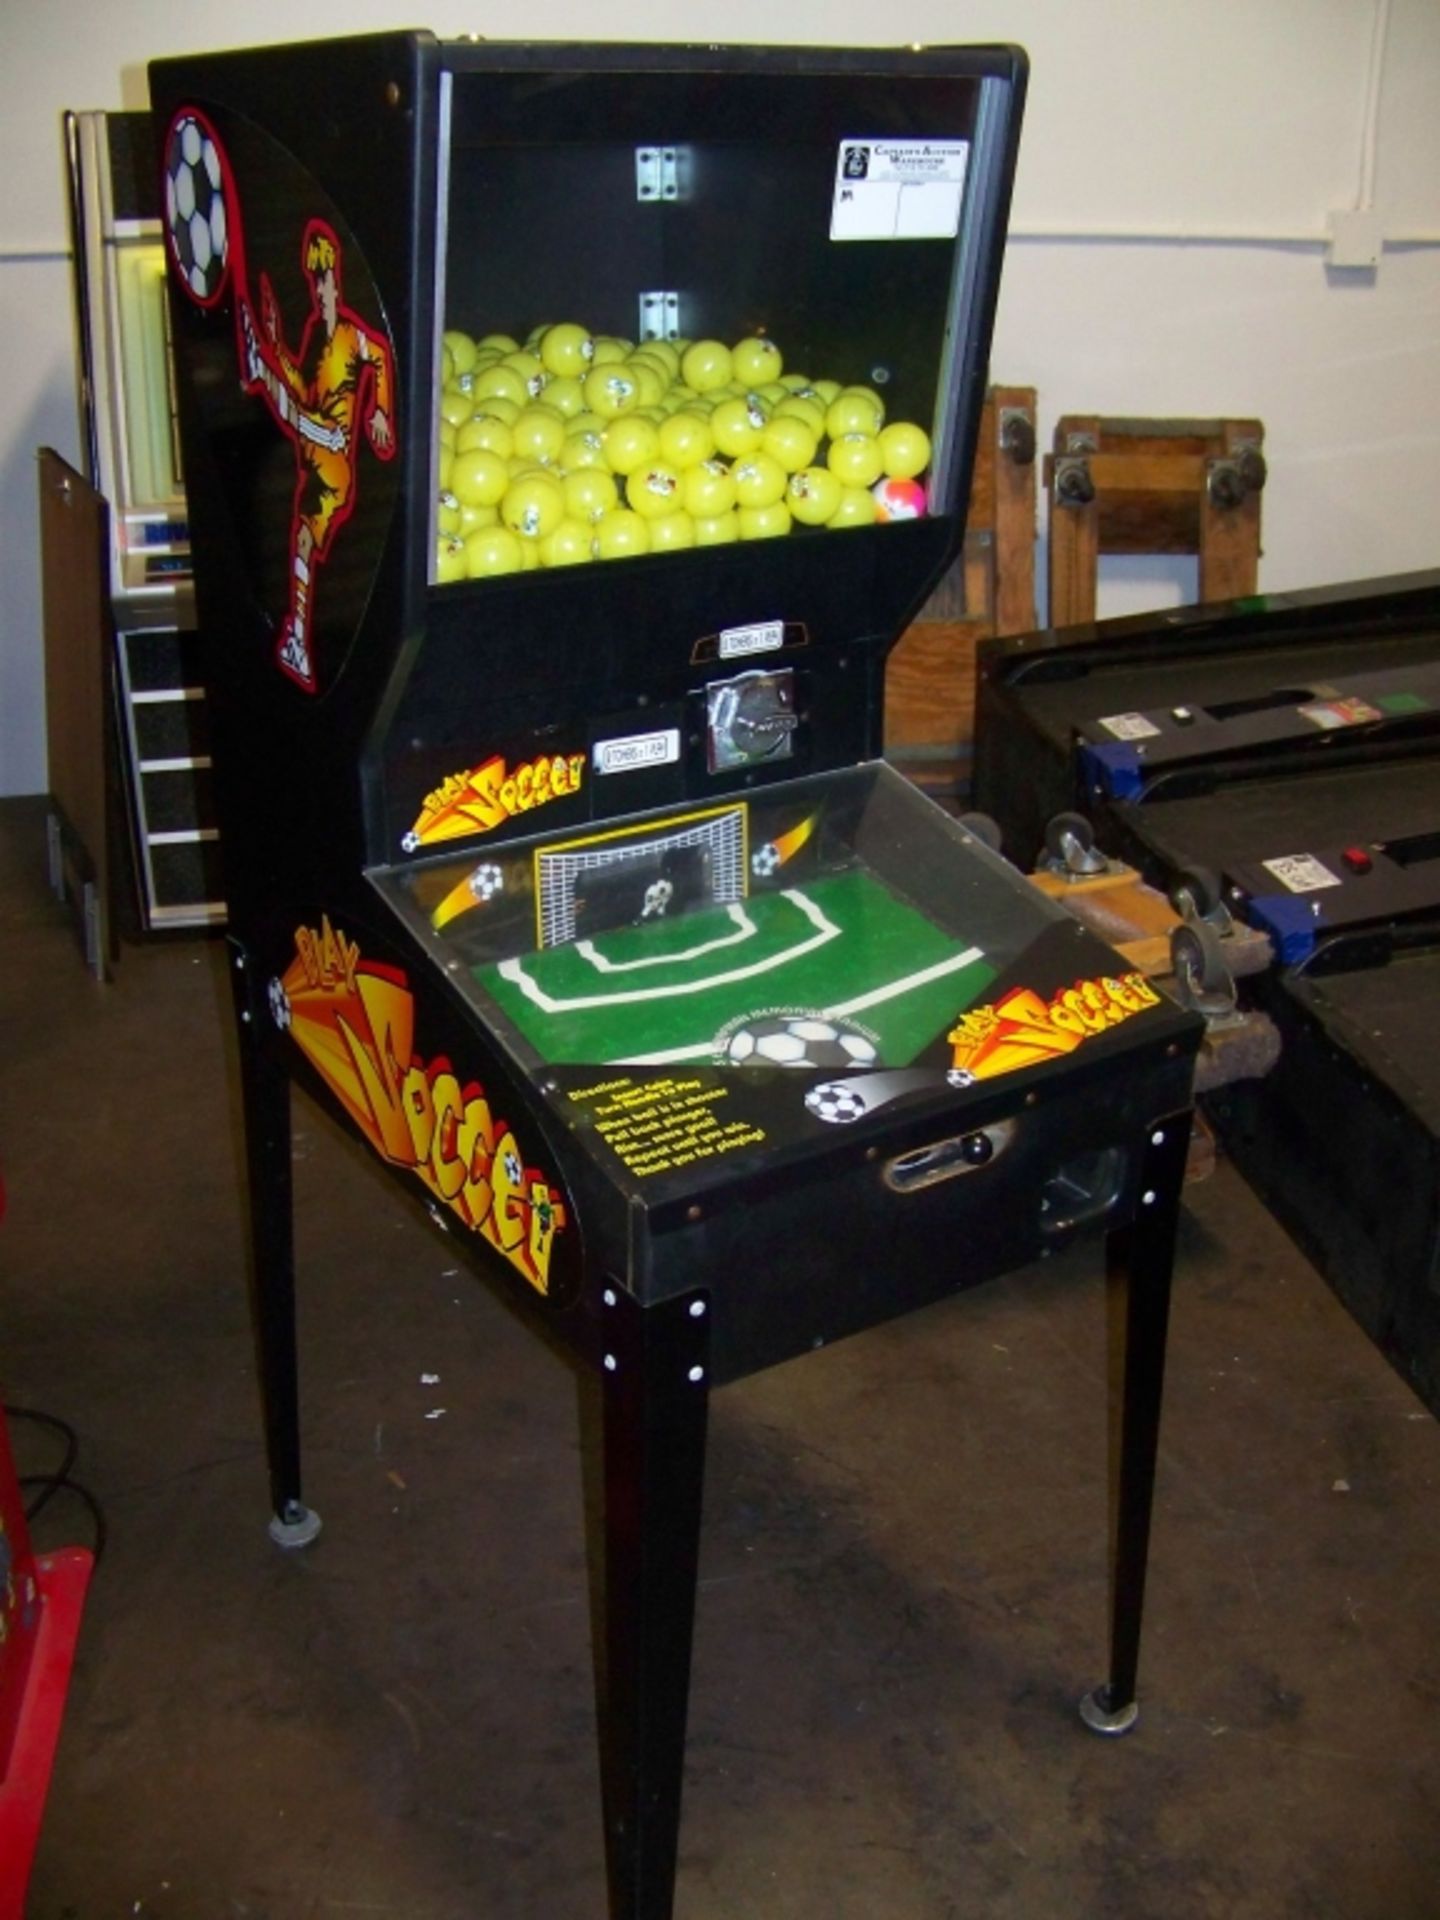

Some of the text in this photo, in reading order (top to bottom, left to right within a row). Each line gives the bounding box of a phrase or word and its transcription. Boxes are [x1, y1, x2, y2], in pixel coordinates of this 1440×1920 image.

[294, 913, 361, 993] PLAY
[947, 1004, 999, 1048] PLAY
[700, 1129, 722, 1143] you
[632, 1159, 670, 1176] Thank
[672, 1152, 695, 1166] you
[695, 1146, 714, 1159] for
